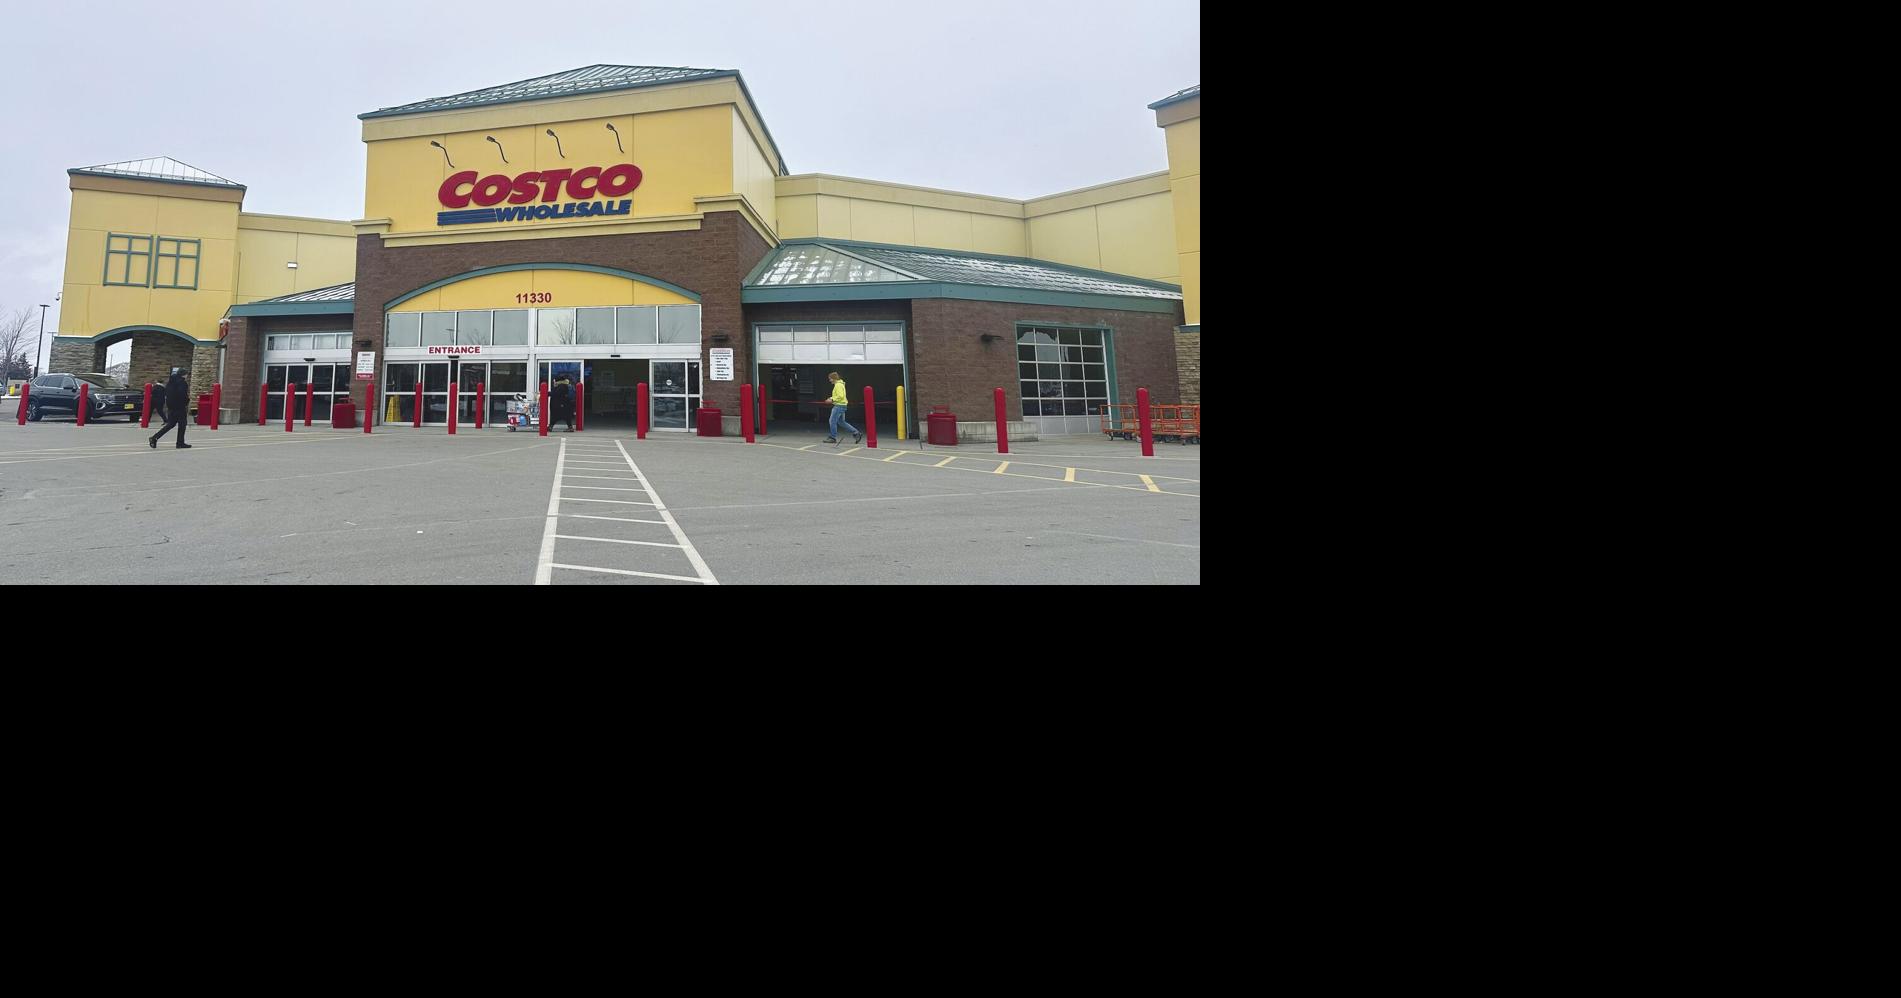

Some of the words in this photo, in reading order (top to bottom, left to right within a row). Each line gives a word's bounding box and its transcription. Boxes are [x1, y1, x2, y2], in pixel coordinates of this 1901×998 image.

[438, 163, 643, 209] COSTCO
[495, 199, 632, 222] WHOLESALE
[515, 292, 552, 304] 11330
[428, 346, 481, 354] ENTRANCE
